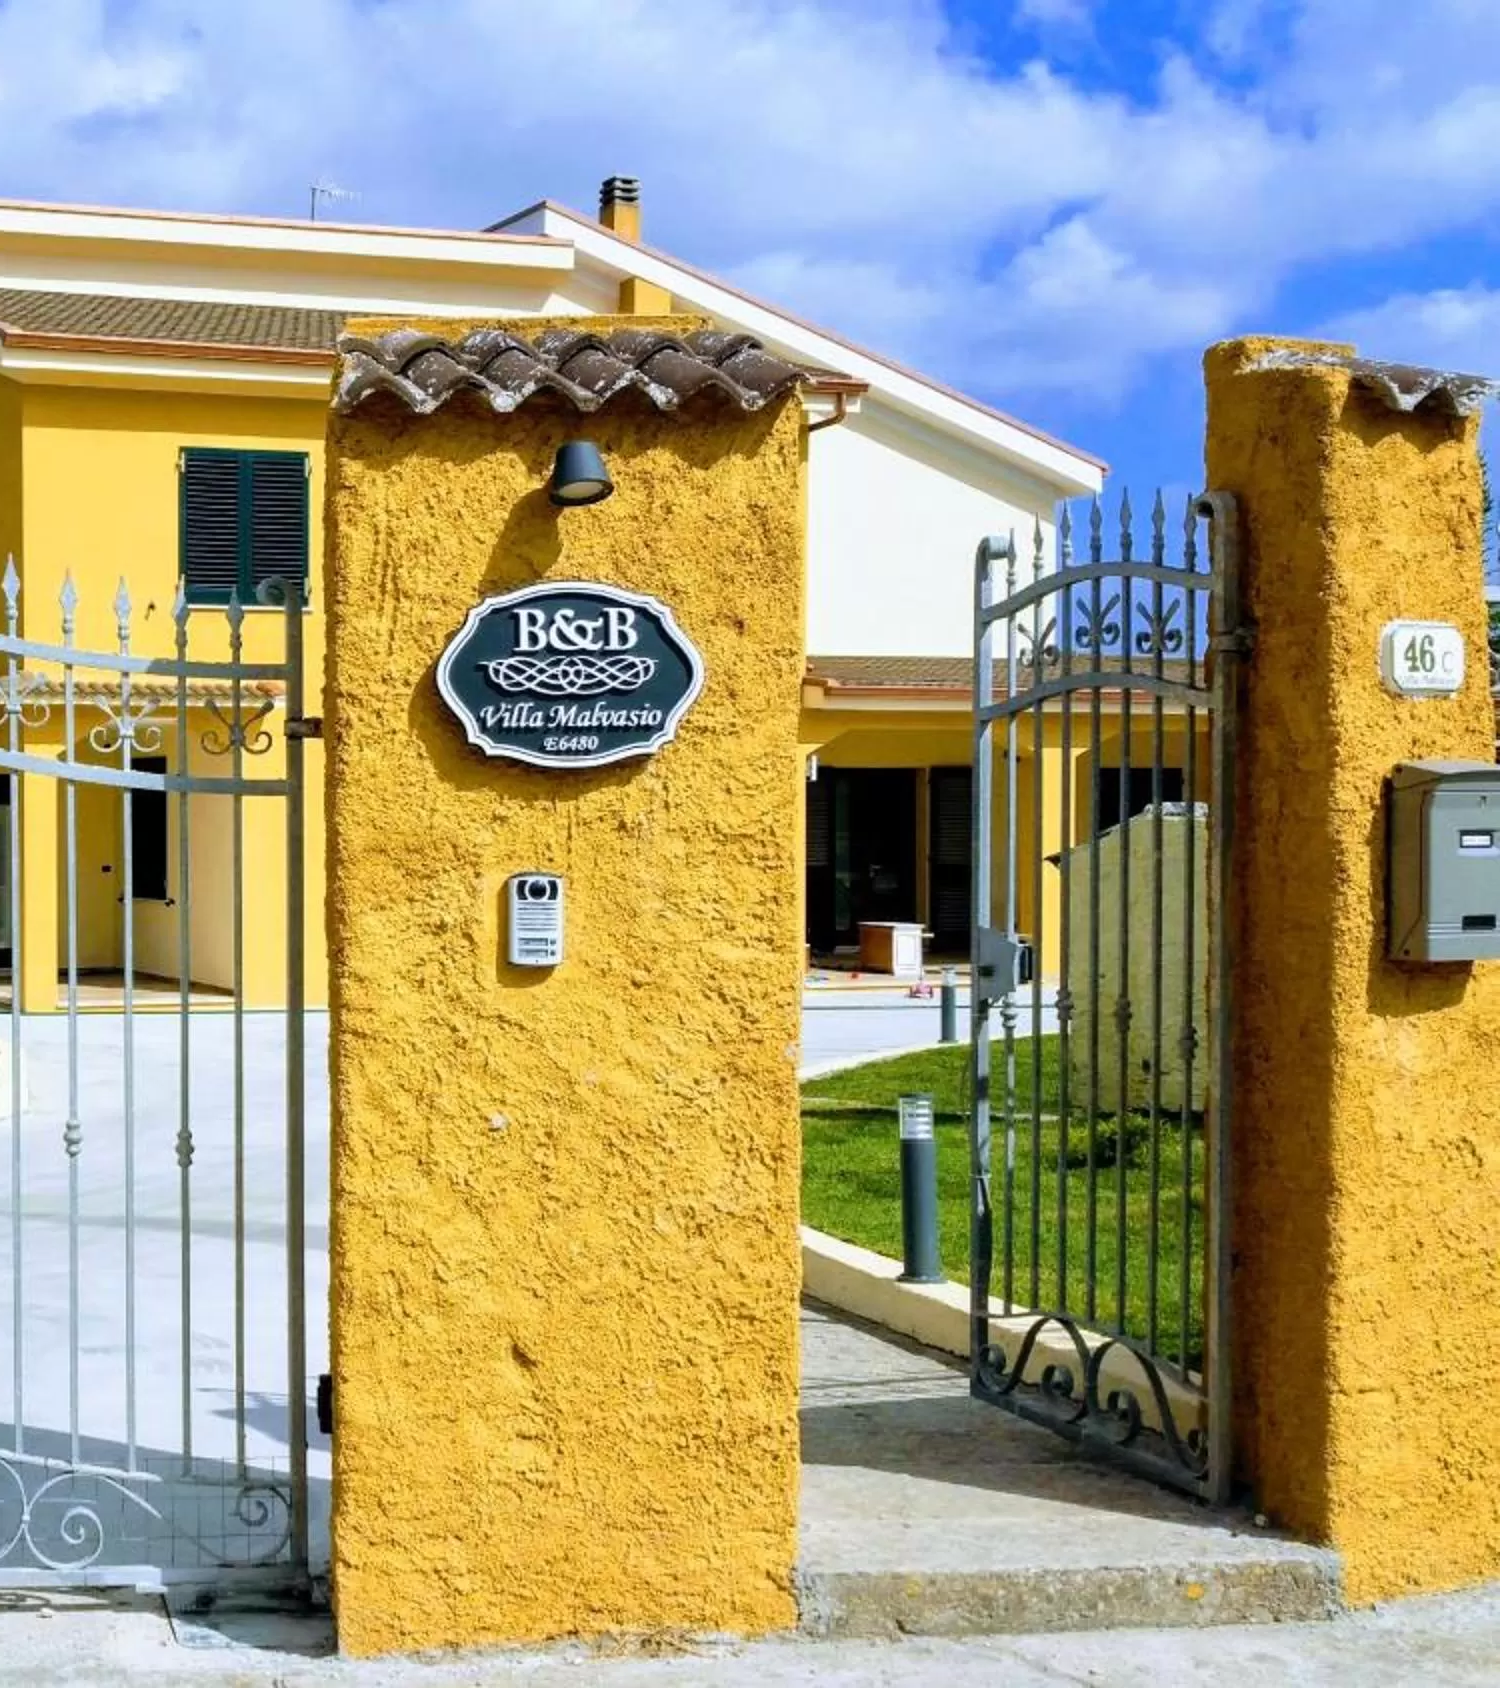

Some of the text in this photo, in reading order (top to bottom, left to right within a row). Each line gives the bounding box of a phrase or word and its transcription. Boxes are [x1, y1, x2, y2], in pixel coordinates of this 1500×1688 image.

[513, 607, 637, 651] B&B
[1403, 634, 1435, 672] 46
[480, 701, 662, 728] Villa Malvasio
[544, 736, 598, 751] E6480
